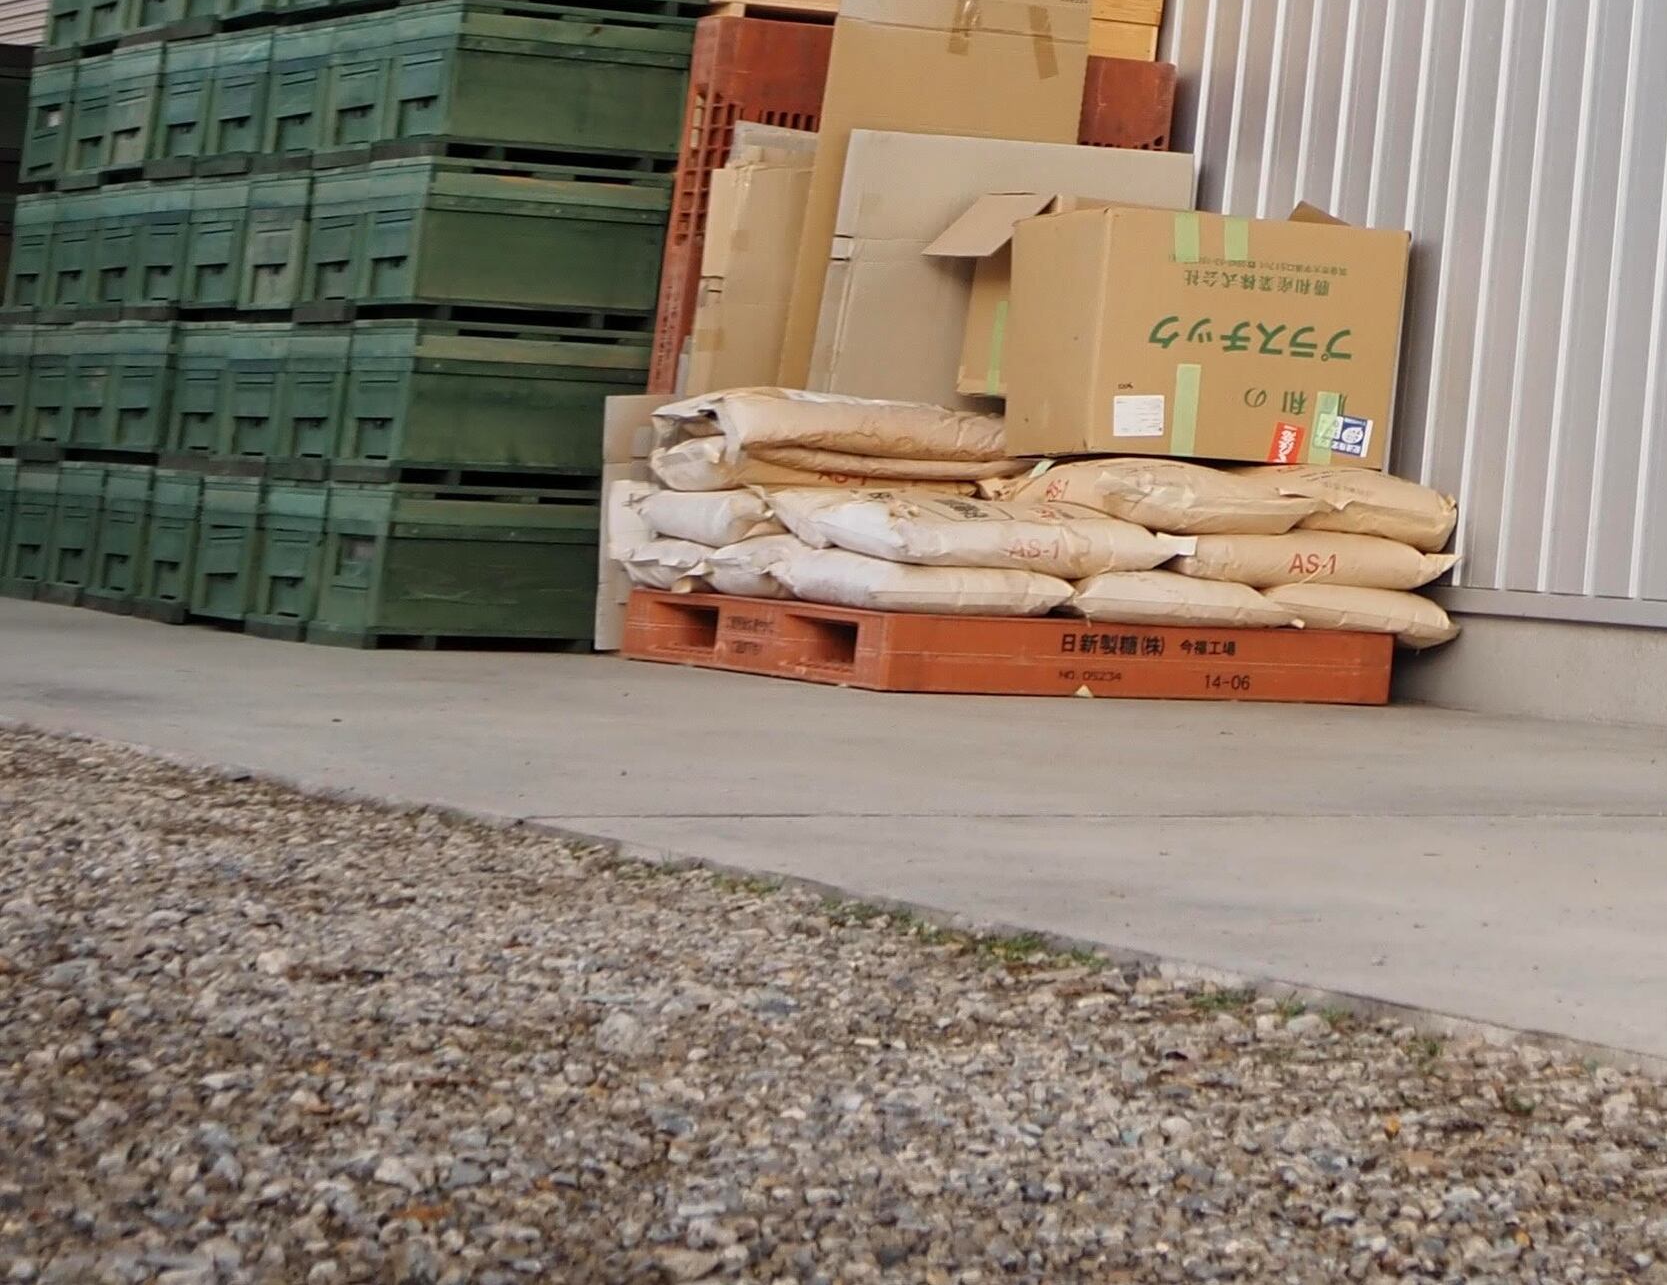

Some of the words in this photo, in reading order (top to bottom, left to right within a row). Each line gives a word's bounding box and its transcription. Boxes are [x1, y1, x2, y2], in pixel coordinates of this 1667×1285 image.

[1147, 315, 1353, 362] プラスチック
[1007, 538, 1060, 560] AS-1
[1287, 552, 1338, 576] AS-1
[1203, 673, 1251, 692] 14-06
